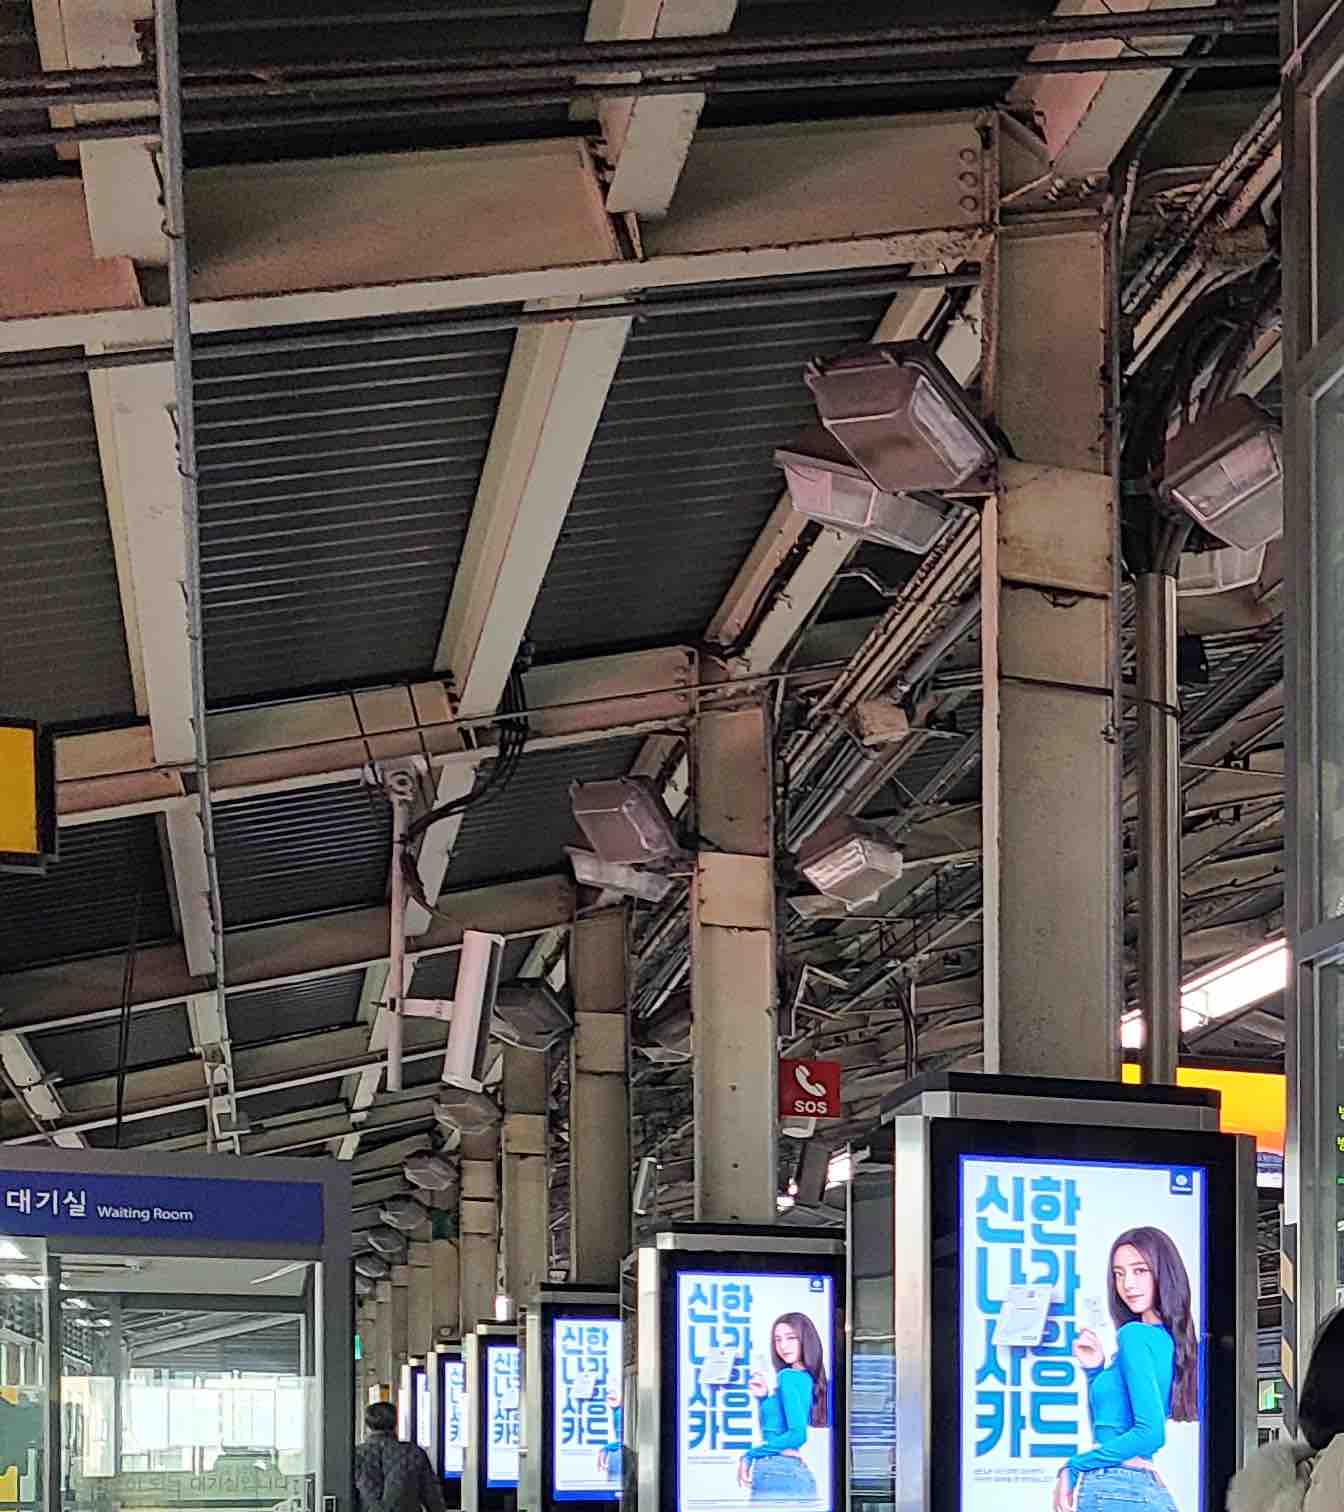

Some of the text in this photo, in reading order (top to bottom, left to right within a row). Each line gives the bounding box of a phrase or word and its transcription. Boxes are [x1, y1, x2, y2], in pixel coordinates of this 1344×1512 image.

[793, 1100, 828, 1114] SOS
[6, 1188, 193, 1222] 대기실 Waiting Room
[975, 1175, 1080, 1246] 신한
[687, 1282, 754, 1325] 신한
[561, 1326, 609, 1356] 신한
[561, 1416, 608, 1445] 카드
[687, 1410, 753, 1450] 카드
[974, 1391, 1079, 1458] 카드
